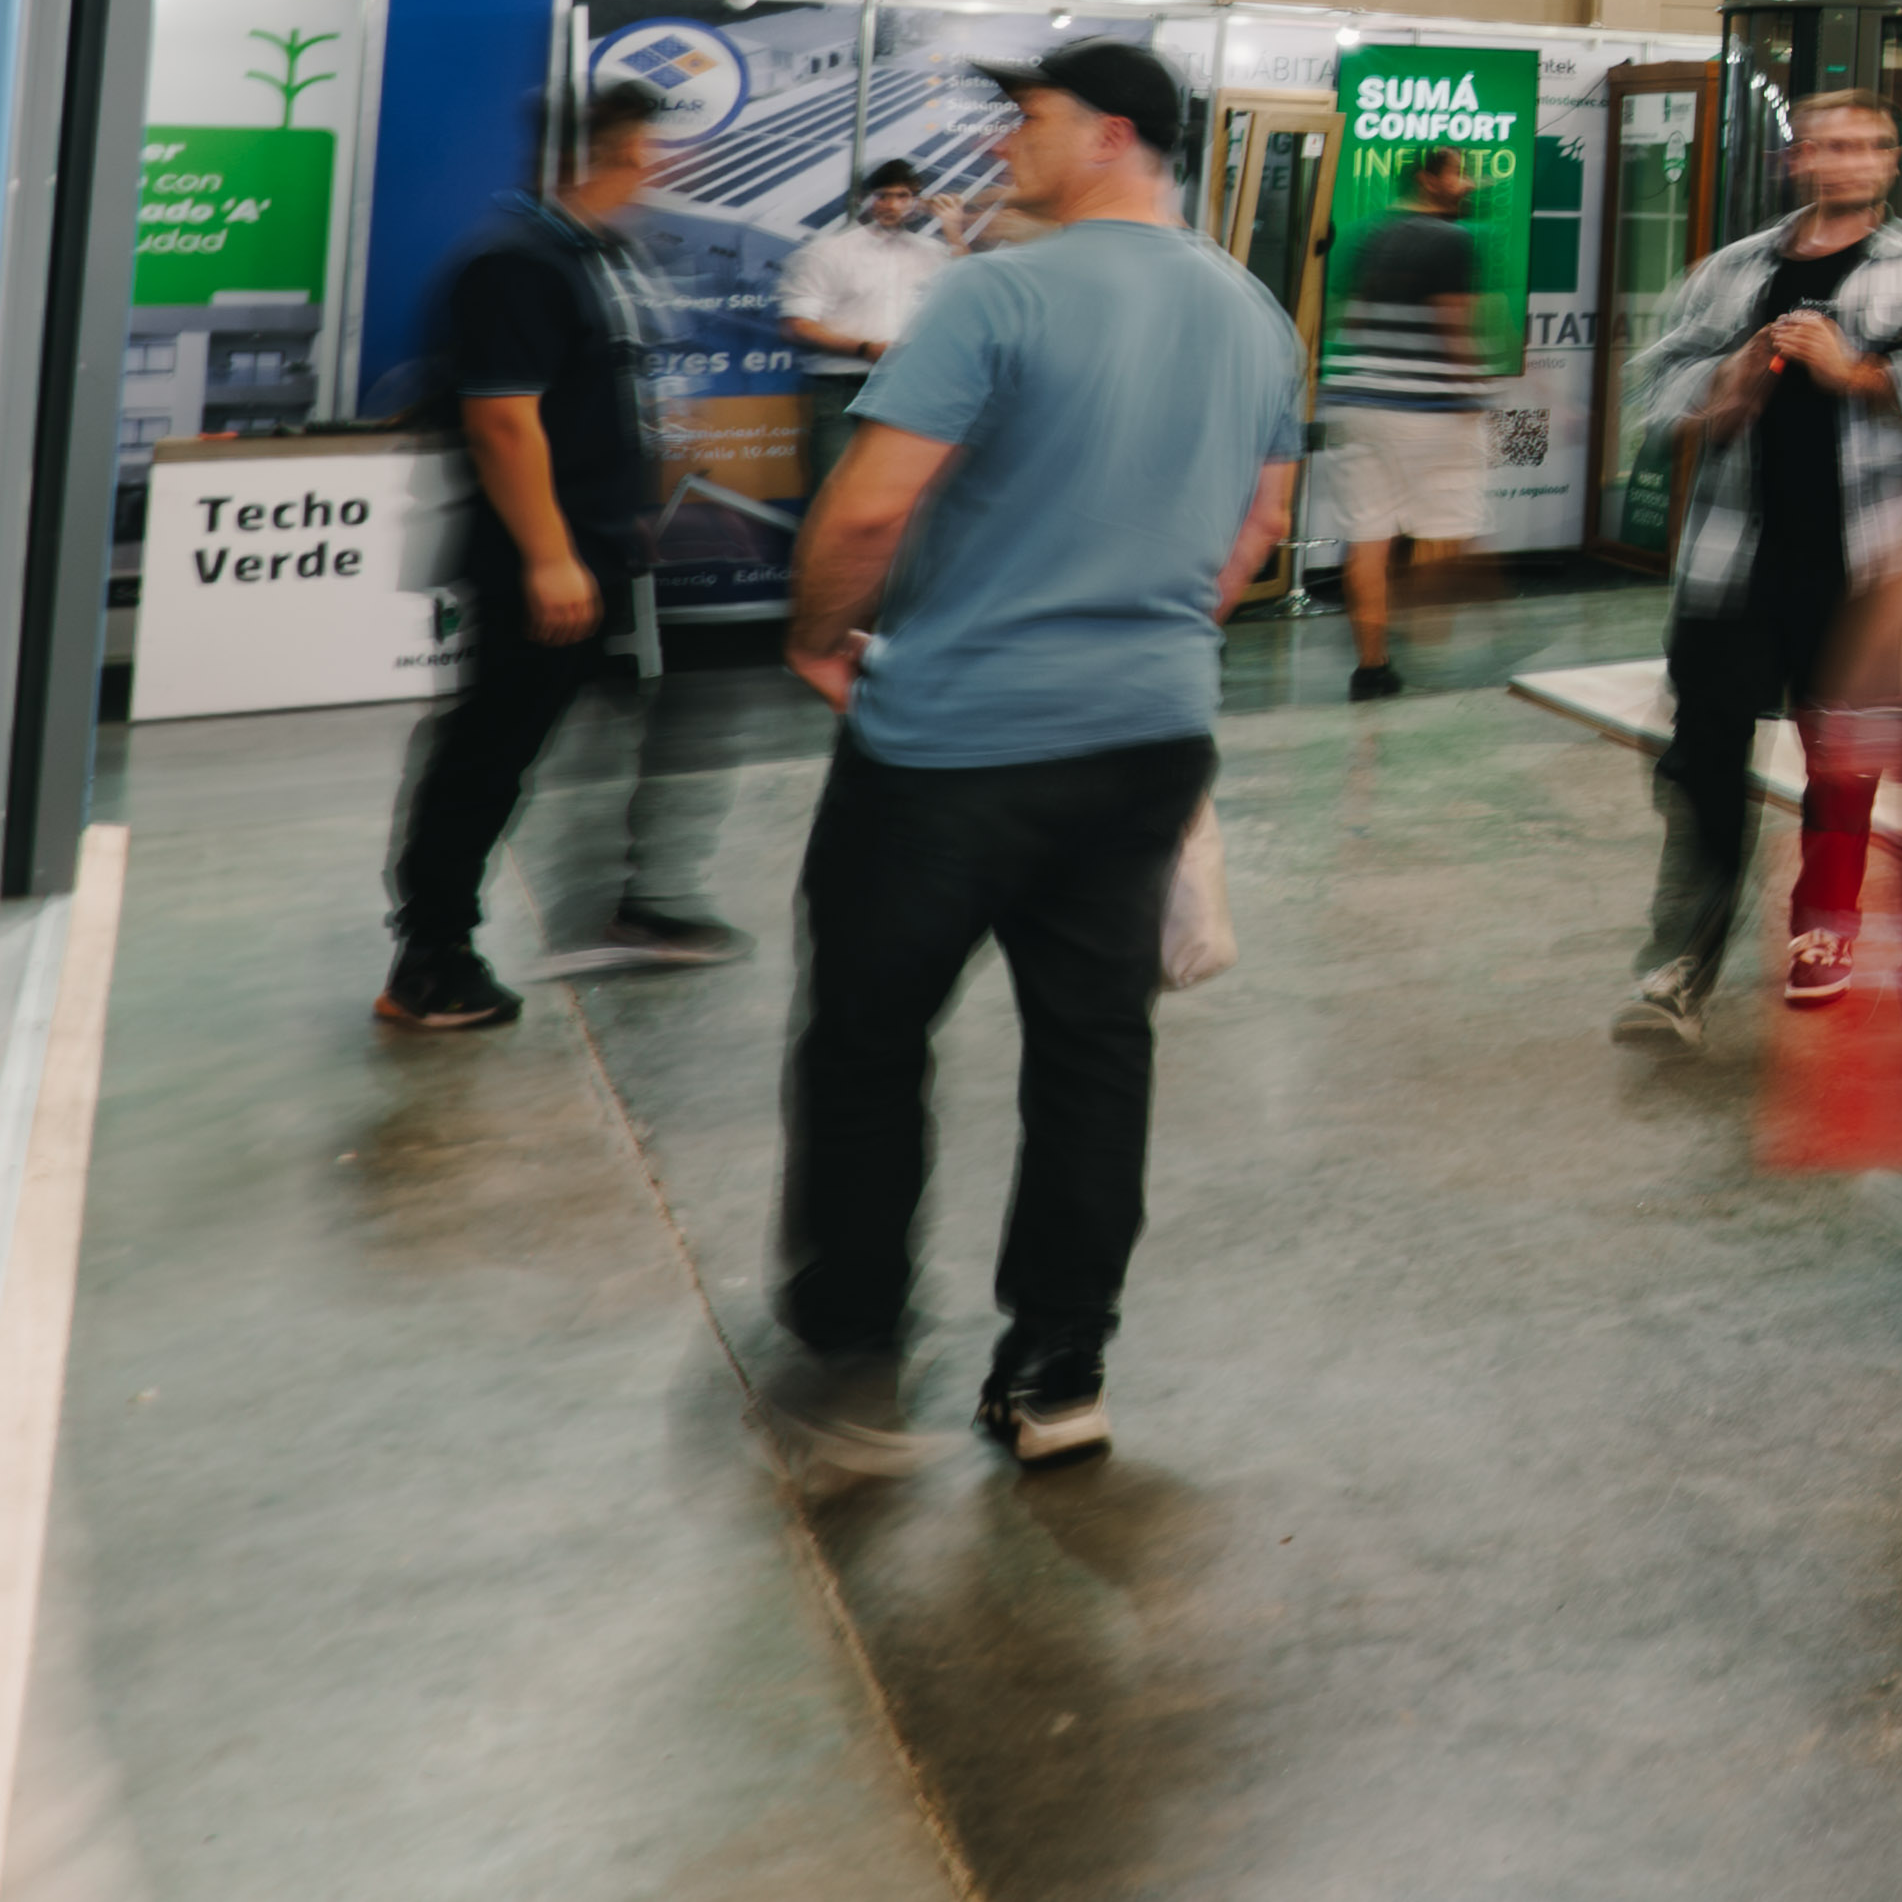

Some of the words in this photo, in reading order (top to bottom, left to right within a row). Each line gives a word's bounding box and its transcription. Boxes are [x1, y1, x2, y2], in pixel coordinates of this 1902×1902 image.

[1229, 49, 1336, 84] HÁBITA
[1357, 71, 1479, 112] SUMÁ
[1354, 112, 1517, 142] CONFORT
[1354, 146, 1517, 179] INFITO
[198, 491, 371, 533] Techo
[195, 541, 363, 584] Verde
